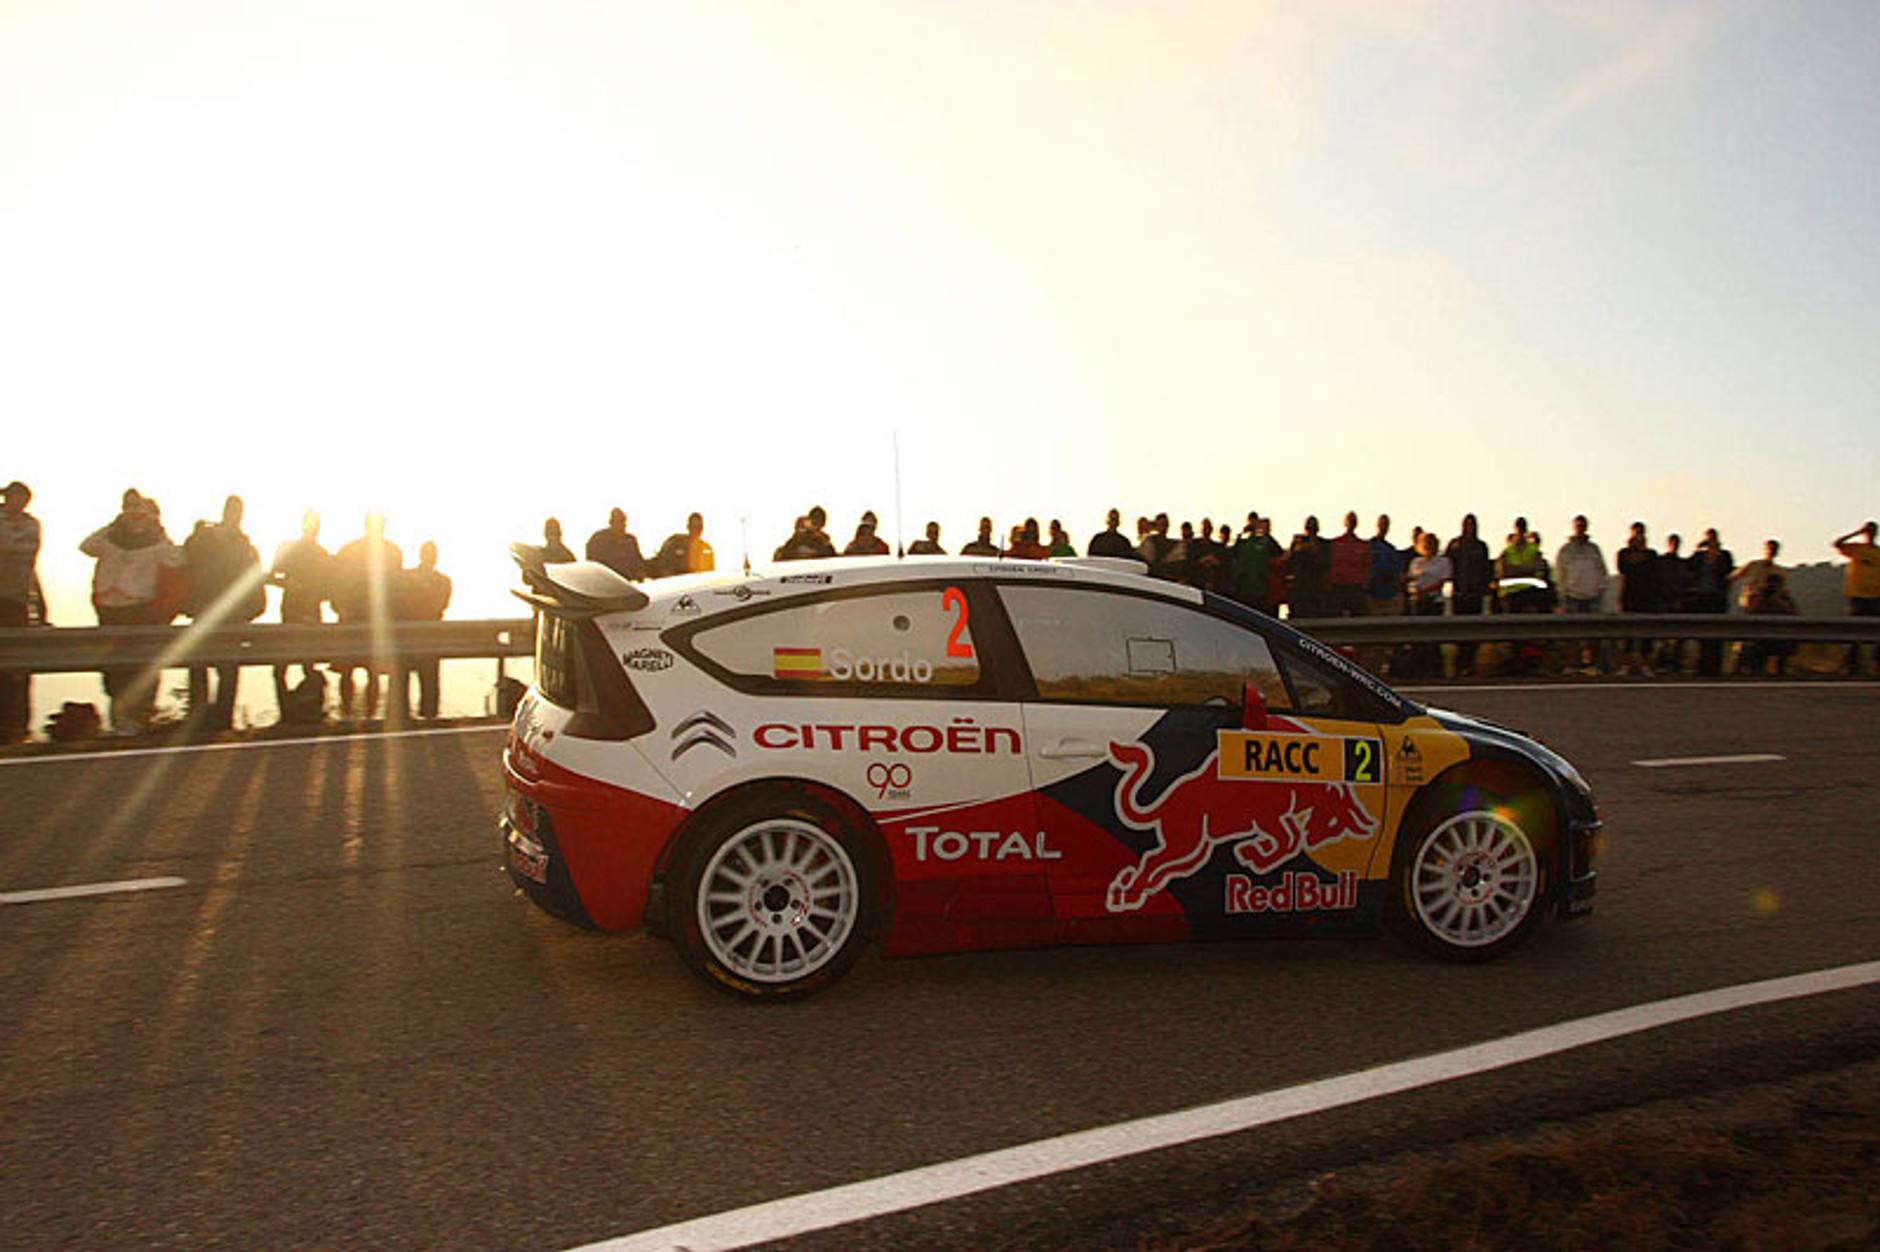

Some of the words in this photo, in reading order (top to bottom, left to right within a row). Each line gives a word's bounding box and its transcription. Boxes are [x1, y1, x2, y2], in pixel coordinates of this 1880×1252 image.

[942, 586, 974, 658] 2
[829, 649, 933, 683] Sordo
[1244, 739, 1320, 774] RACC
[1354, 740, 1372, 781] 2
